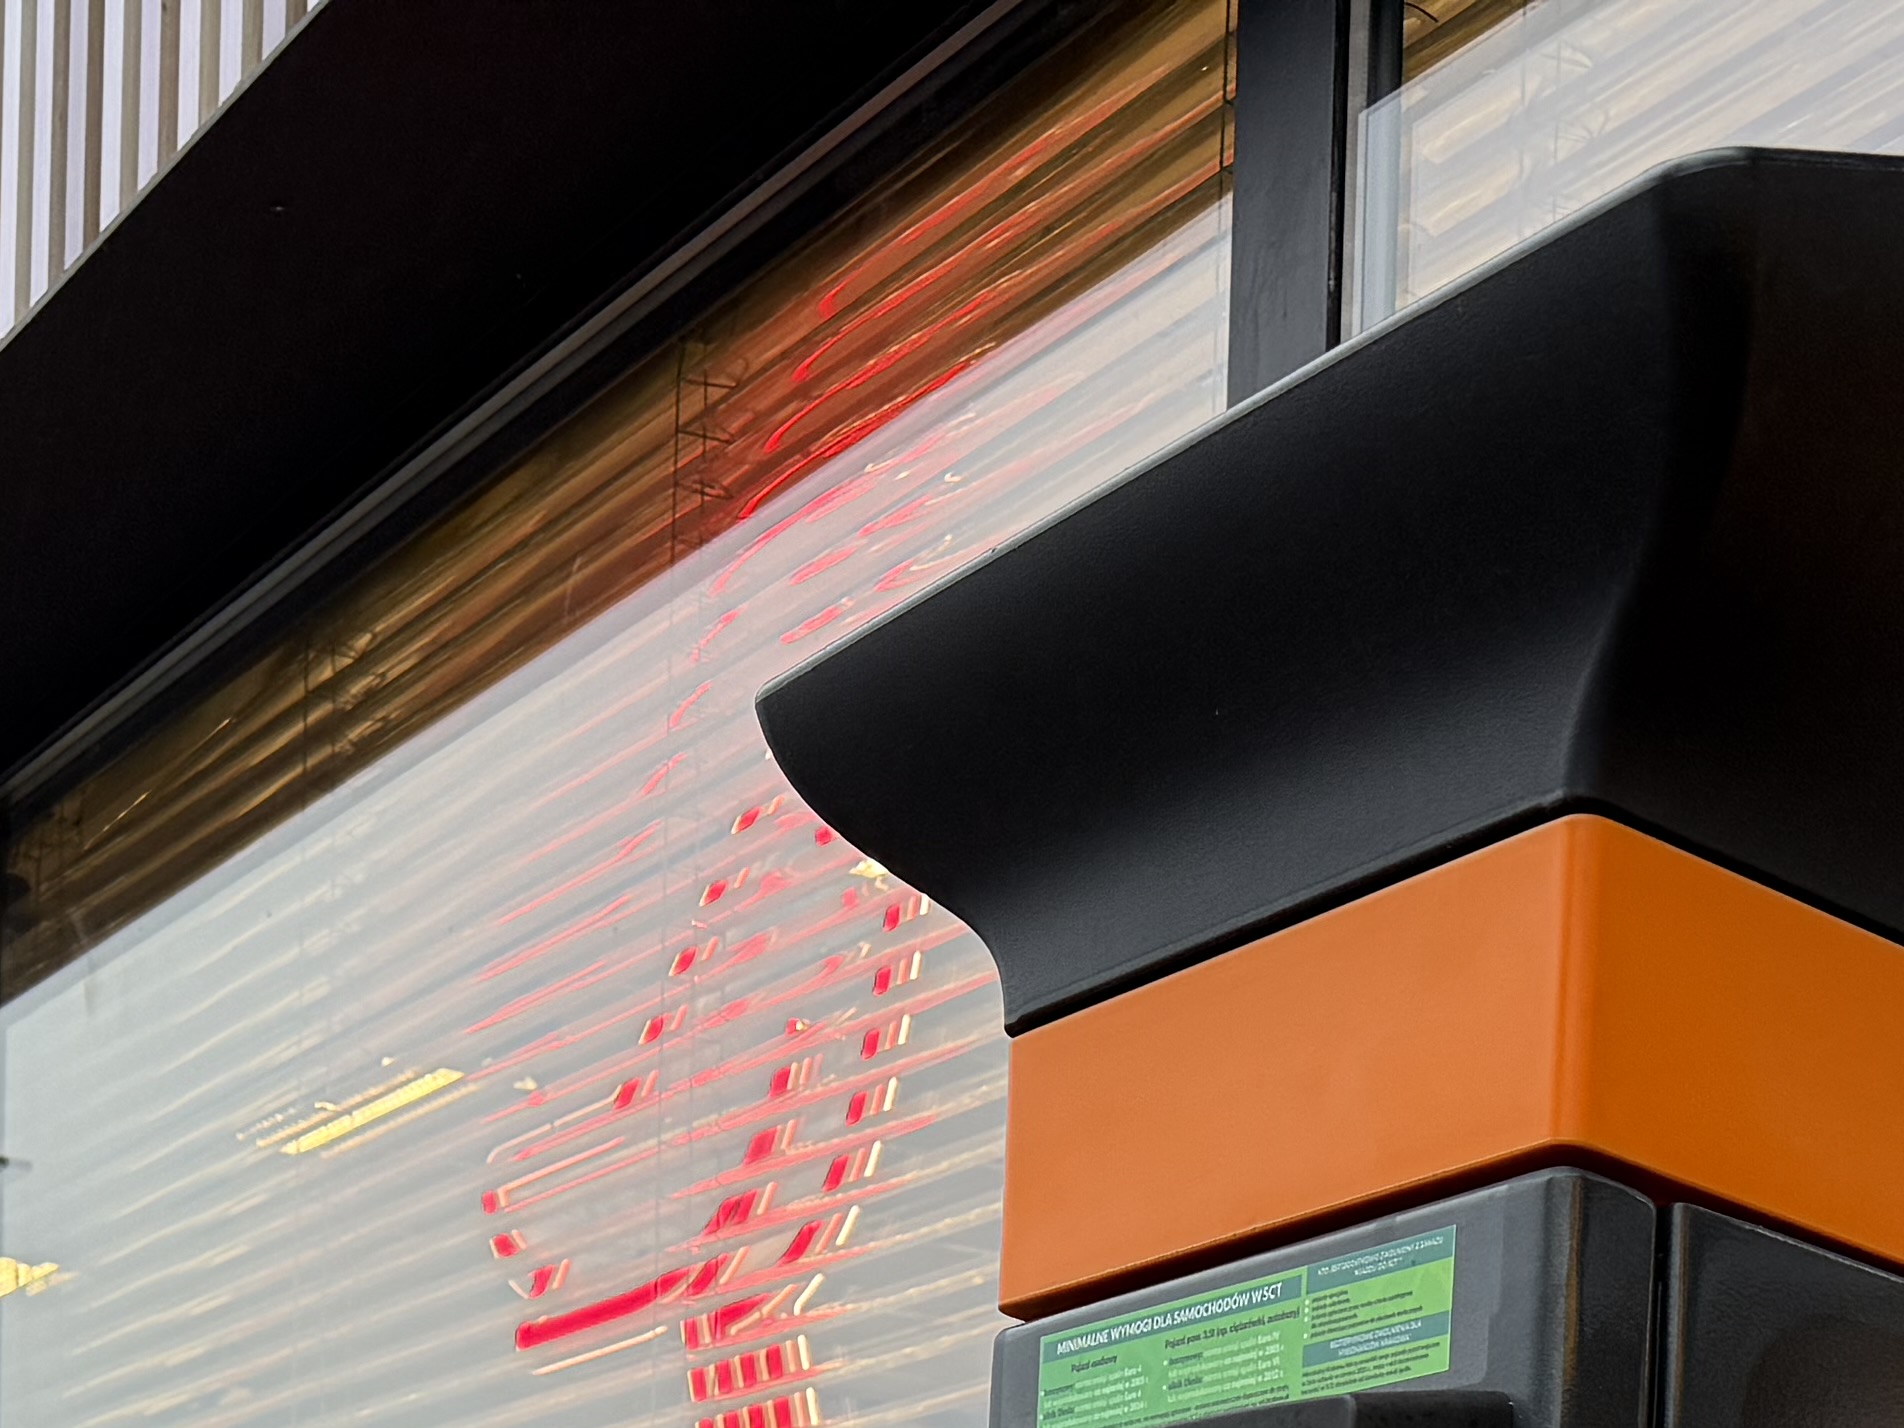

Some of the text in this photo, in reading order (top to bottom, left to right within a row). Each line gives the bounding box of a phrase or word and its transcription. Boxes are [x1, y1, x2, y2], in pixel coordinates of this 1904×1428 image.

[1057, 1281, 1283, 1355] MINIMALNE WYMOGI DLA SAMOCHODÓW W SCT
